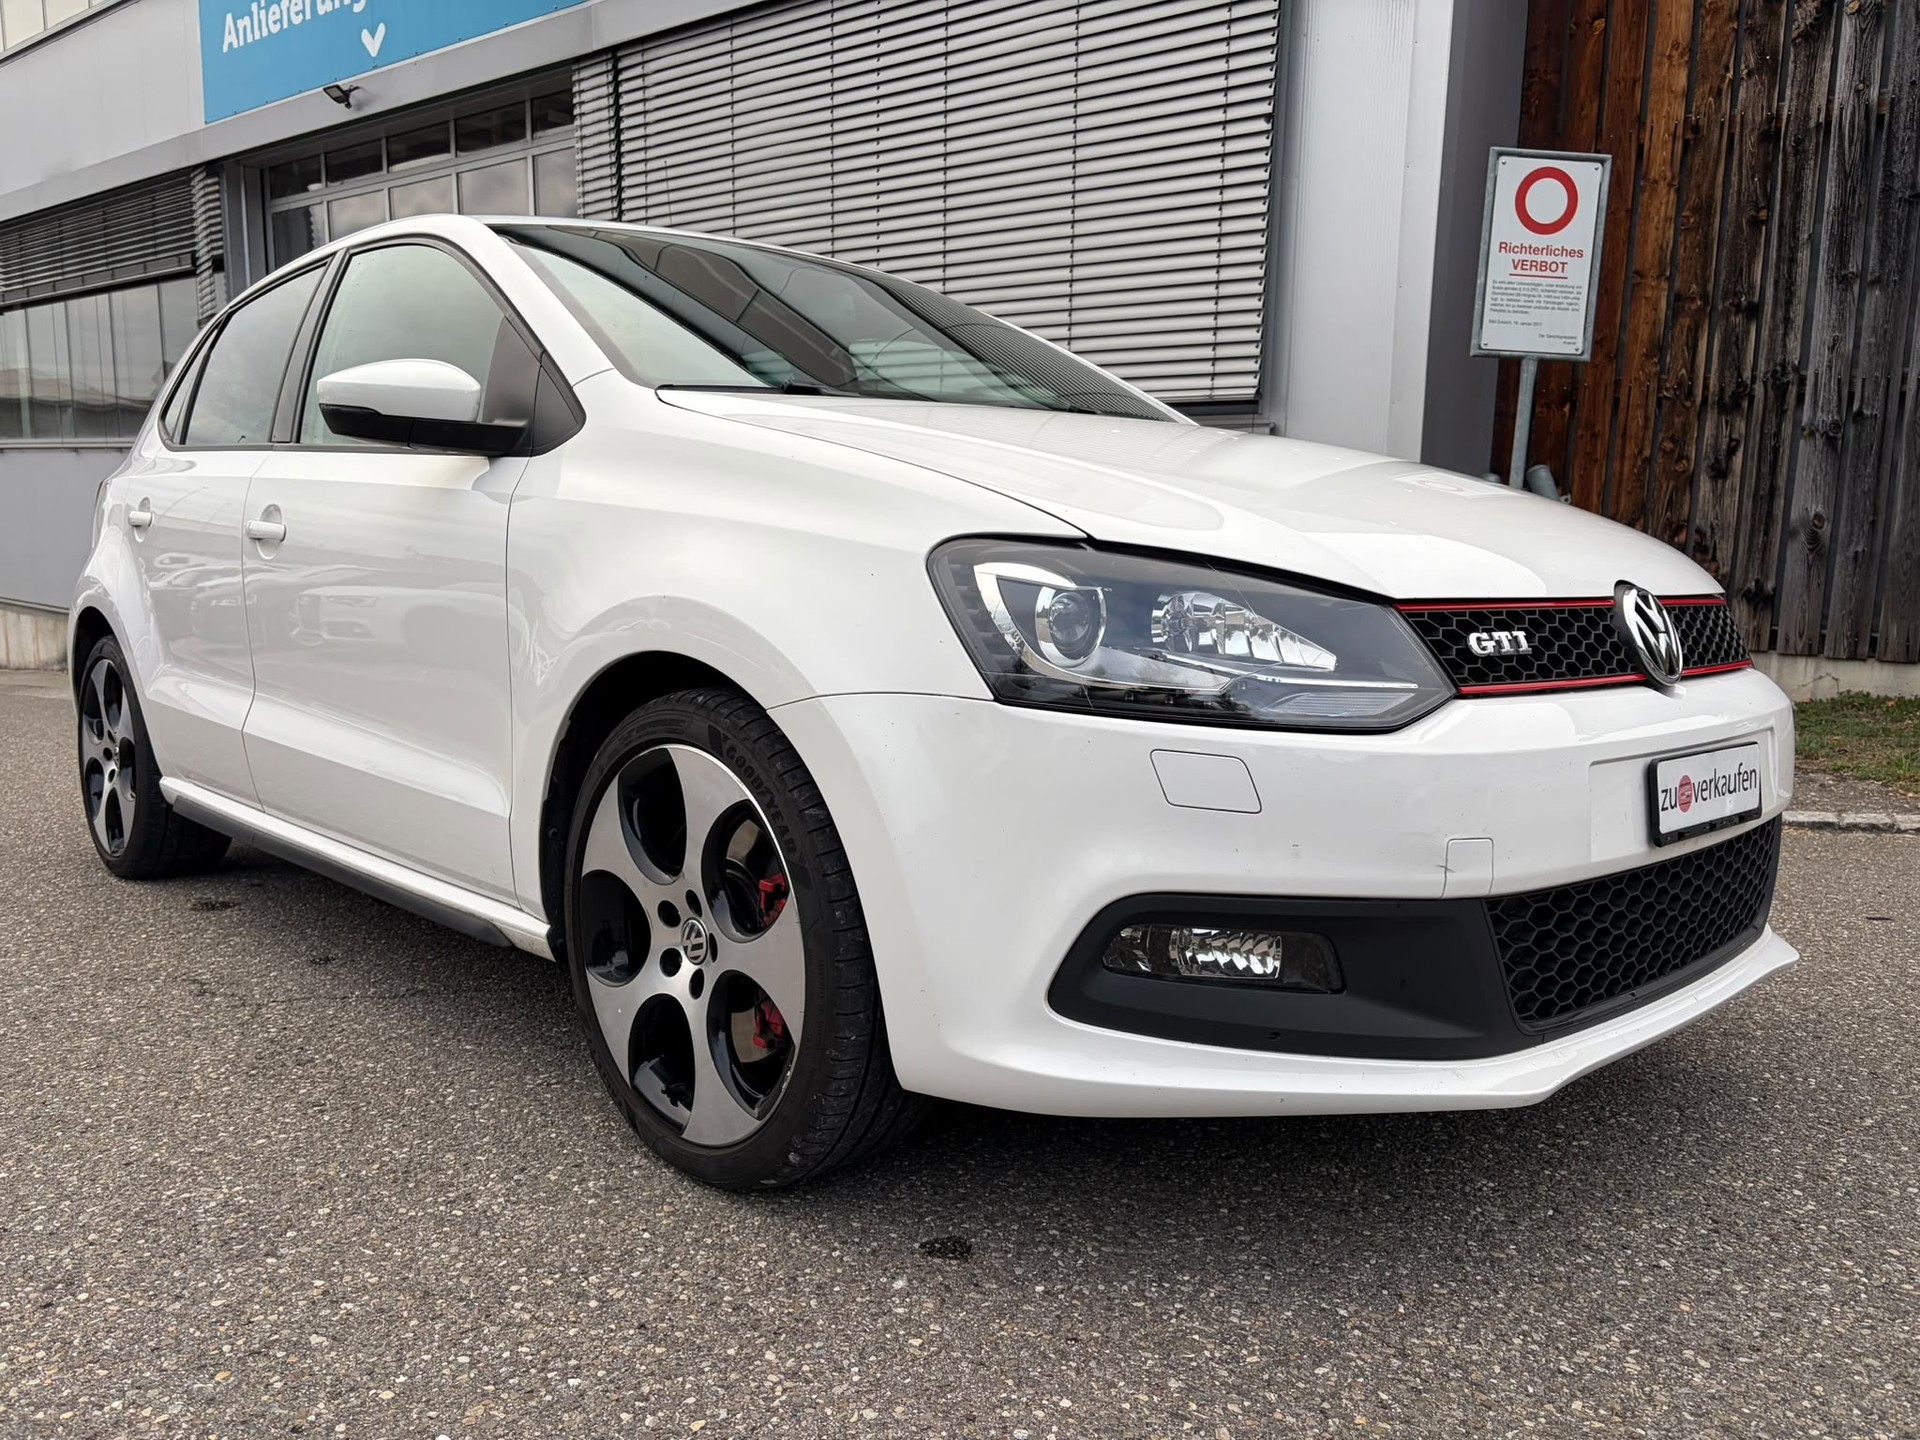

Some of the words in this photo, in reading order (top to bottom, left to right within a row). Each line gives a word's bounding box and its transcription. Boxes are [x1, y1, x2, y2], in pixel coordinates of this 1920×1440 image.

[1498, 241, 1584, 259] Richterliches
[1512, 258, 1568, 274] VERBOT
[1467, 631, 1532, 657] GTI
[726, 746, 797, 853] GOODYEAR
[1661, 786, 1678, 812] zu
[1693, 762, 1757, 803] verkaufen
